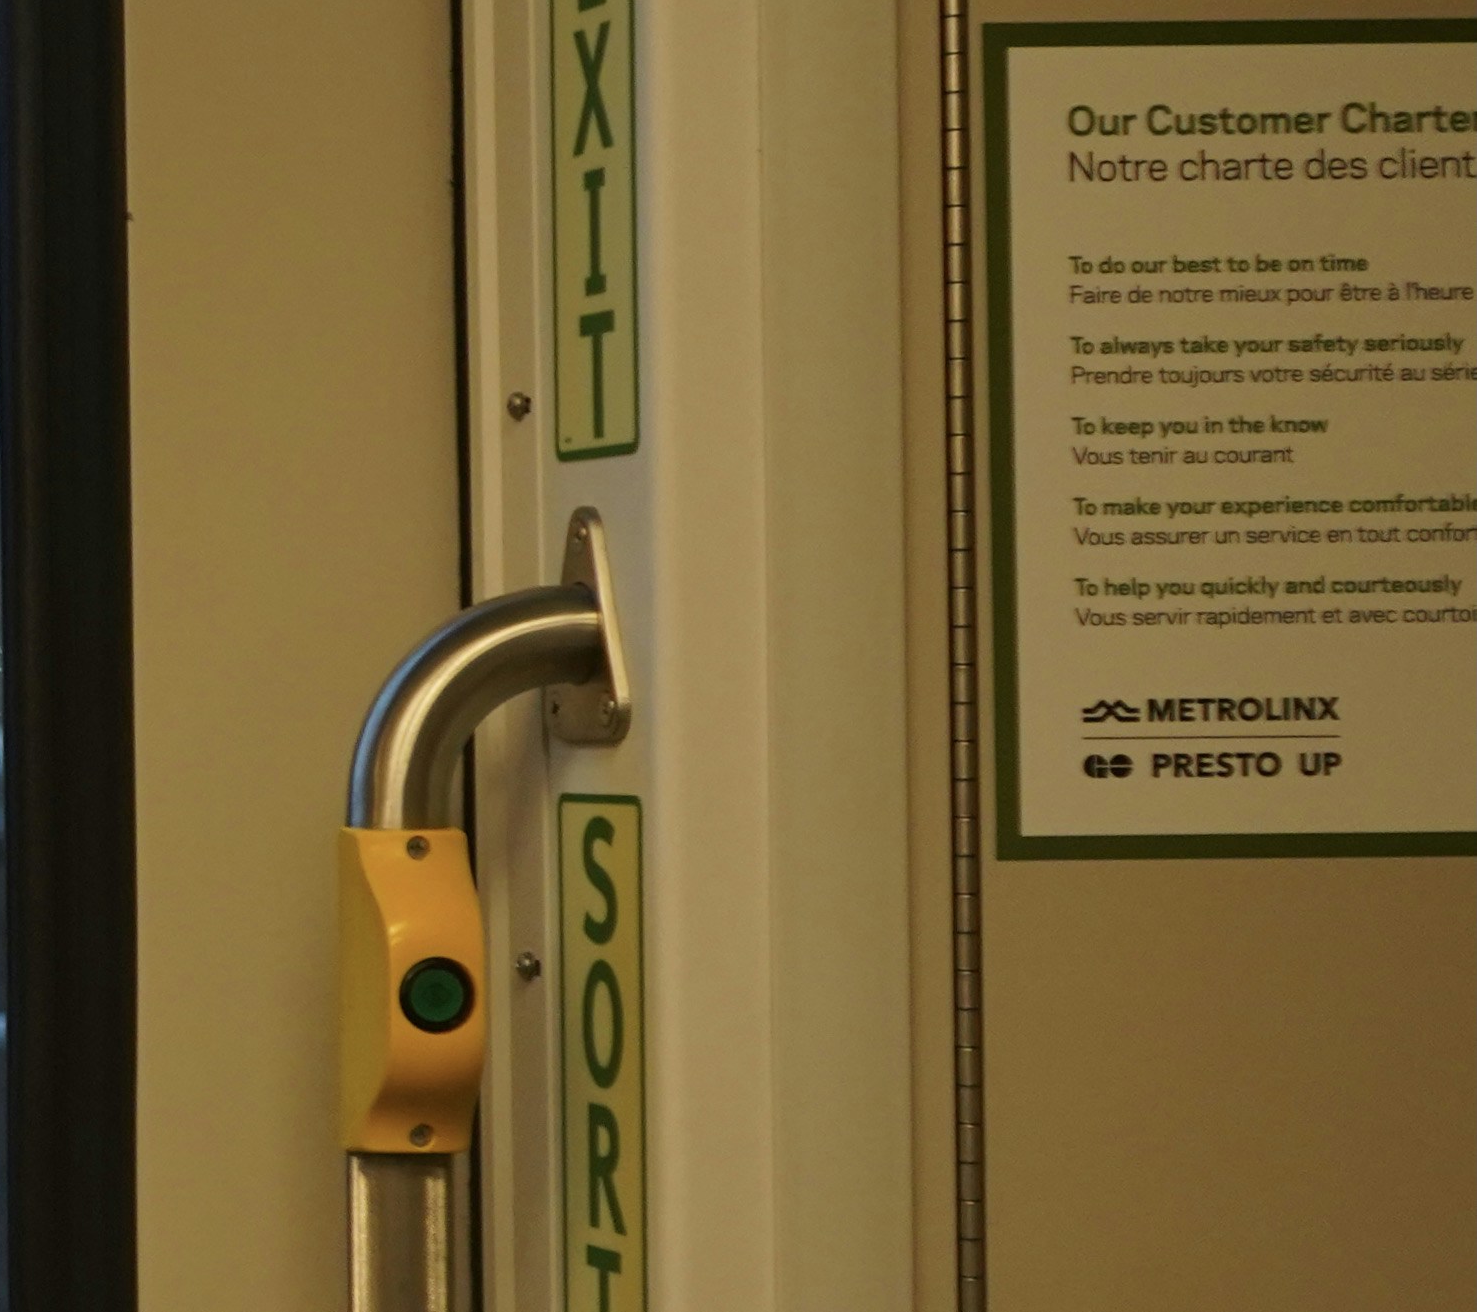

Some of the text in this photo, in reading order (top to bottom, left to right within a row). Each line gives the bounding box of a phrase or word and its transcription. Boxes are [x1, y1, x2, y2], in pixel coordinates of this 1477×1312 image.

[1068, 104, 1137, 137] Our
[1146, 104, 1332, 135] Customer
[1069, 151, 1168, 183] Notre
[1179, 150, 1293, 181] charte
[1305, 148, 1367, 180] des
[1070, 254, 1368, 274] To do our best to be on time
[1070, 285, 1122, 304] Faire
[1128, 285, 1152, 304] de
[1158, 286, 1214, 303] notre
[1220, 285, 1279, 302] mieux
[1287, 287, 1333, 307] pour
[1339, 283, 1381, 302] être
[1387, 283, 1400, 301] à
[1071, 332, 1465, 359] To always take your safety seriously
[1071, 365, 1152, 384] Prendre
[1158, 365, 1245, 388] toujours
[1250, 365, 1303, 383] votre
[1309, 361, 1395, 382] sécurité
[1400, 366, 1426, 382] au
[1071, 416, 1329, 439] To keep you in the know
[1073, 446, 1294, 465] Vous tenir au courant
[1072, 498, 1098, 517] To
[1102, 498, 1162, 516] make
[1167, 500, 1216, 519] your
[1221, 496, 1343, 517] experience
[1073, 526, 1125, 546] Vous
[1130, 528, 1209, 545] assurer
[1214, 528, 1241, 545] un
[1245, 526, 1321, 545] service
[1327, 528, 1352, 543] en
[1357, 526, 1401, 543] tout
[1074, 576, 1462, 600] To help you quickly and courteously
[1074, 608, 1126, 627] Vous
[1132, 608, 1190, 626] servir
[1197, 607, 1316, 628] rapidement
[1322, 607, 1343, 624] et
[1348, 608, 1397, 624] avec
[1146, 696, 1340, 723] METROLINX
[1151, 751, 1283, 779] PRESTO
[1298, 751, 1342, 778] UP
